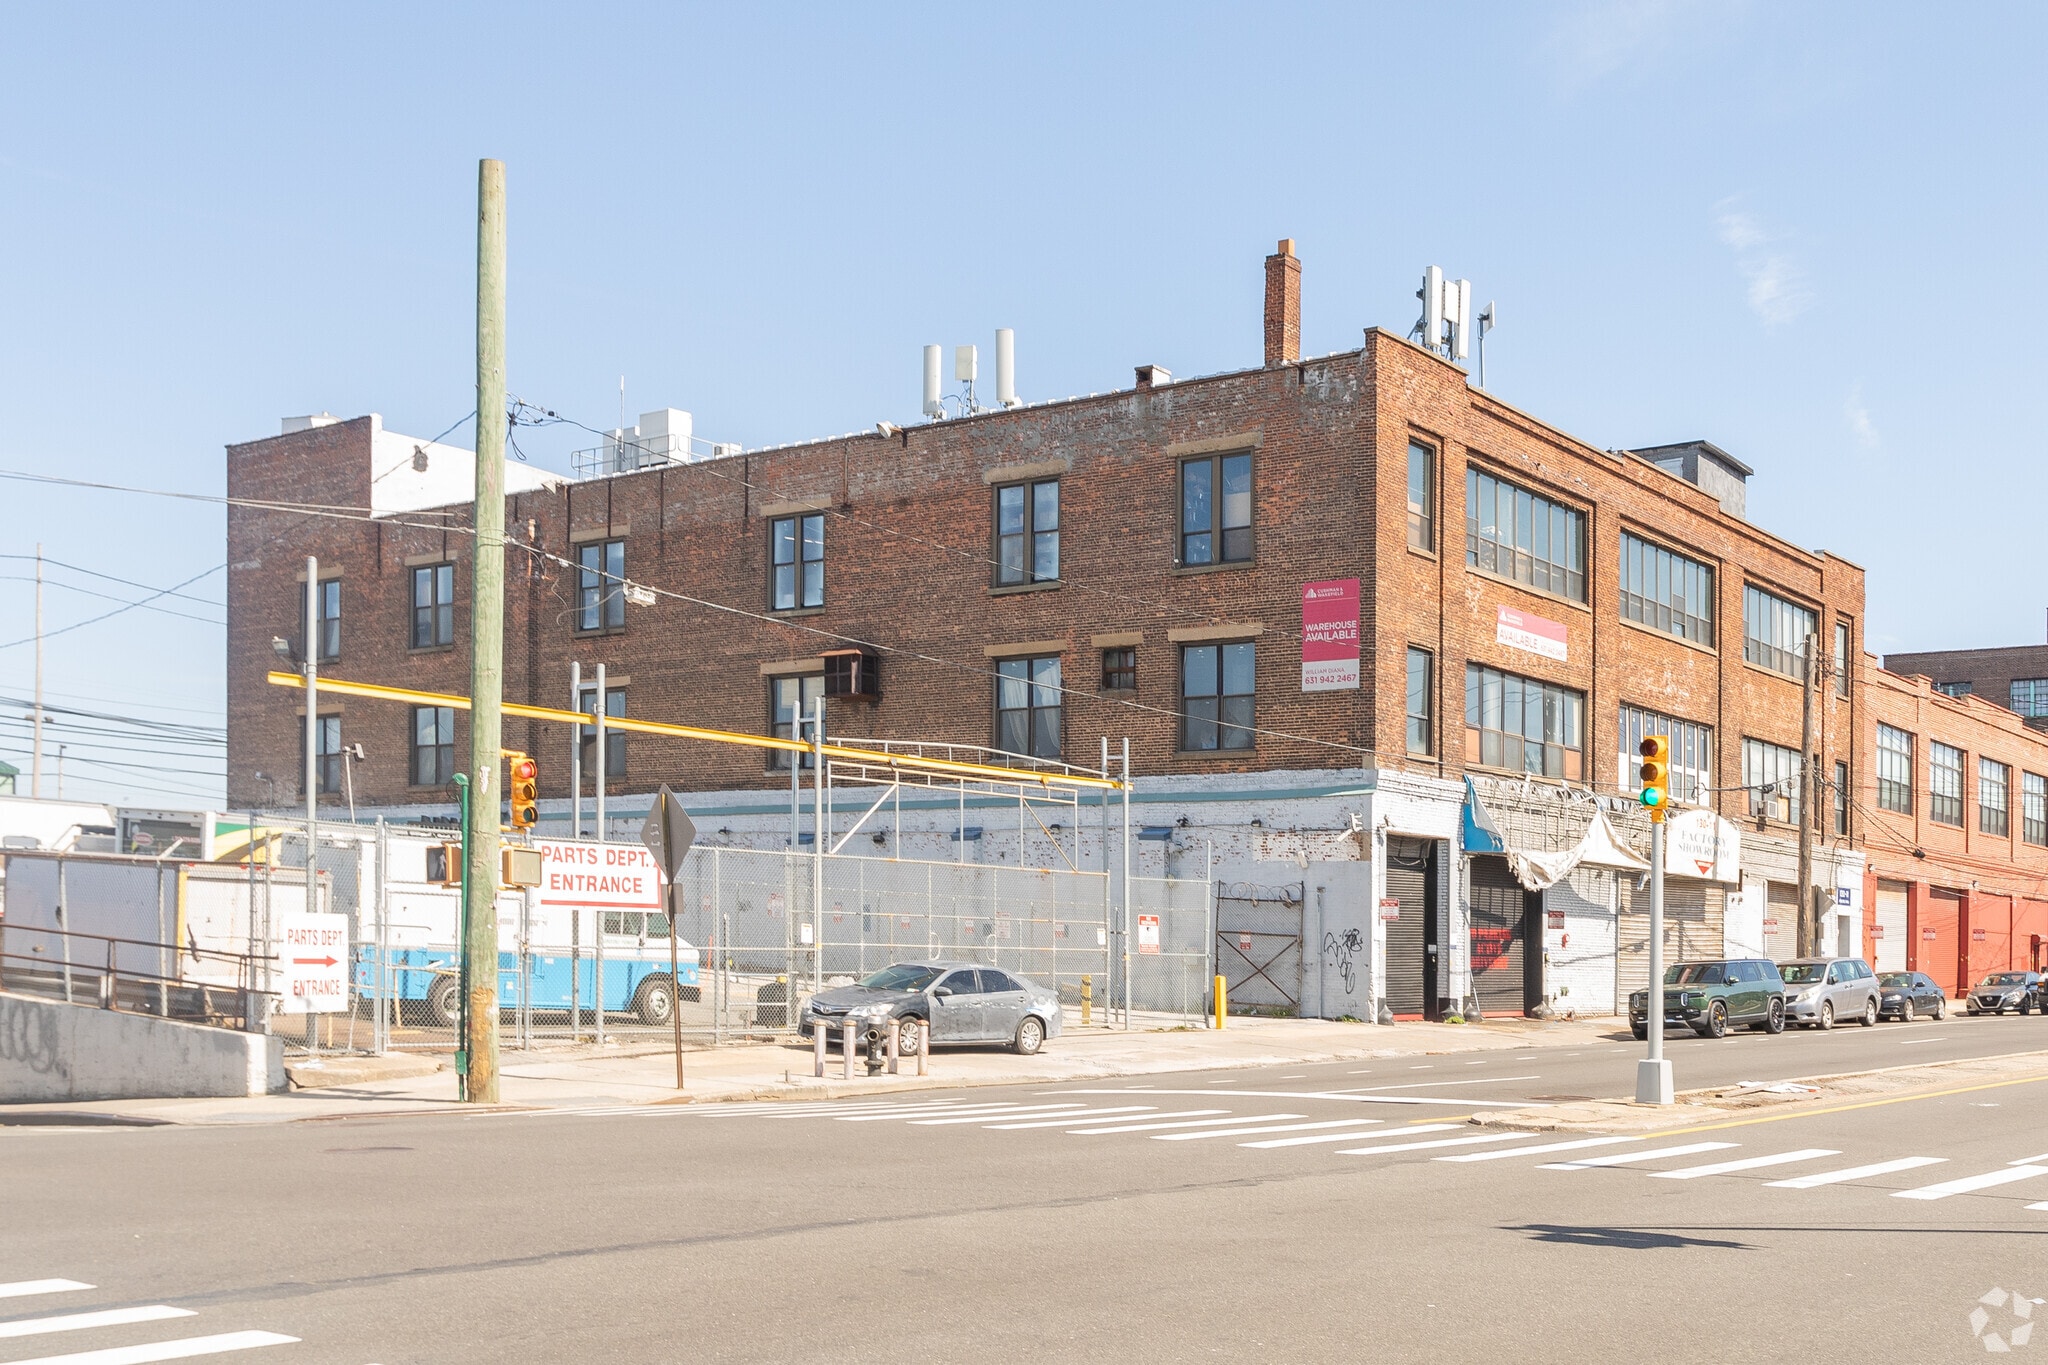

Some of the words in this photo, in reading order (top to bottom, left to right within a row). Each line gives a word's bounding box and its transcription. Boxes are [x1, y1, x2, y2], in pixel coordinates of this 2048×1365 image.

[1305, 620, 1357, 632] WAREHOUSE
[1305, 629, 1357, 642] AVAILABLE
[1499, 629, 1538, 650] AVAILABLE
[1305, 676, 1318, 684] 631
[1320, 675, 1335, 684] 942
[1337, 674, 1357, 683] 2467
[1681, 830, 1727, 848] FACTORY
[541, 845, 598, 865] PARTS
[606, 849, 649, 868] DEPT.
[1678, 843, 1730, 860] SHOWROOM
[550, 873, 643, 893] ENTRANCE
[287, 928, 318, 946] PARTS
[293, 979, 340, 996] ENTRANCE
